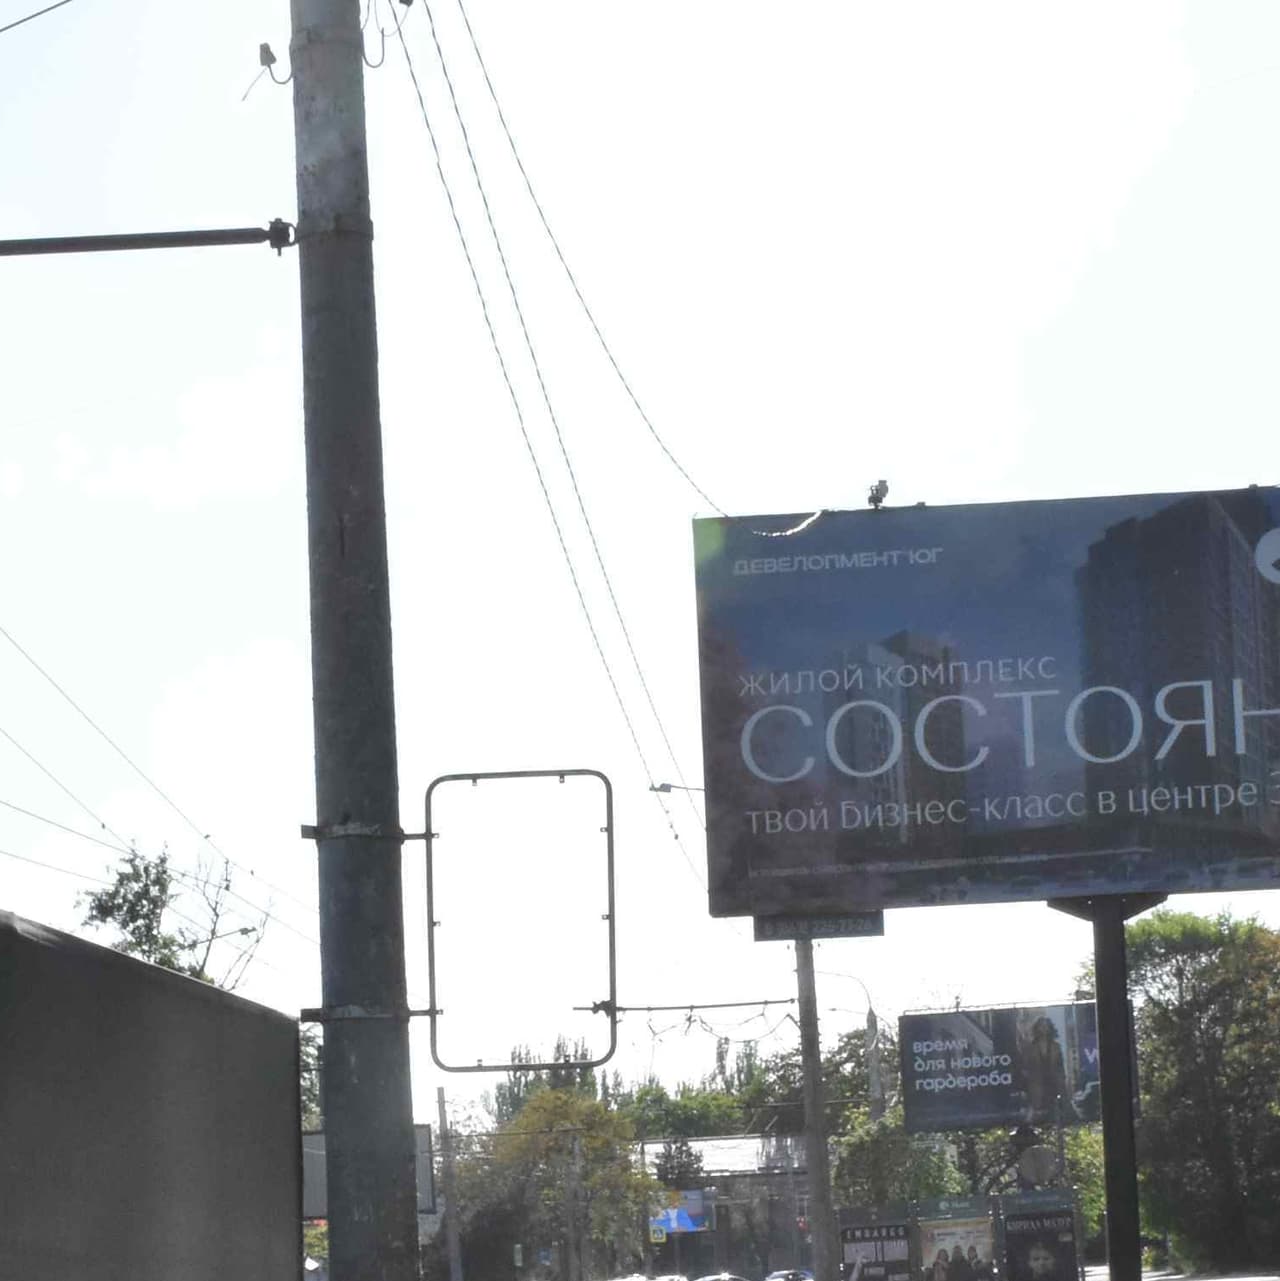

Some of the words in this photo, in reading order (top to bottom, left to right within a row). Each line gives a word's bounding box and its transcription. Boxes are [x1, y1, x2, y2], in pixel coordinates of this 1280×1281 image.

[732, 549, 902, 577] ДЕВЕЛОПМЕНТ
[738, 664, 865, 698] ЖИЛОЙ
[875, 655, 1058, 689] КОМПЛЕКС
[1097, 790, 1117, 815] в
[1128, 780, 1259, 816] центре
[912, 1037, 969, 1056] время
[914, 1057, 946, 1072] для
[950, 1053, 1012, 1070] нового
[915, 1070, 1012, 1092] гардероба
